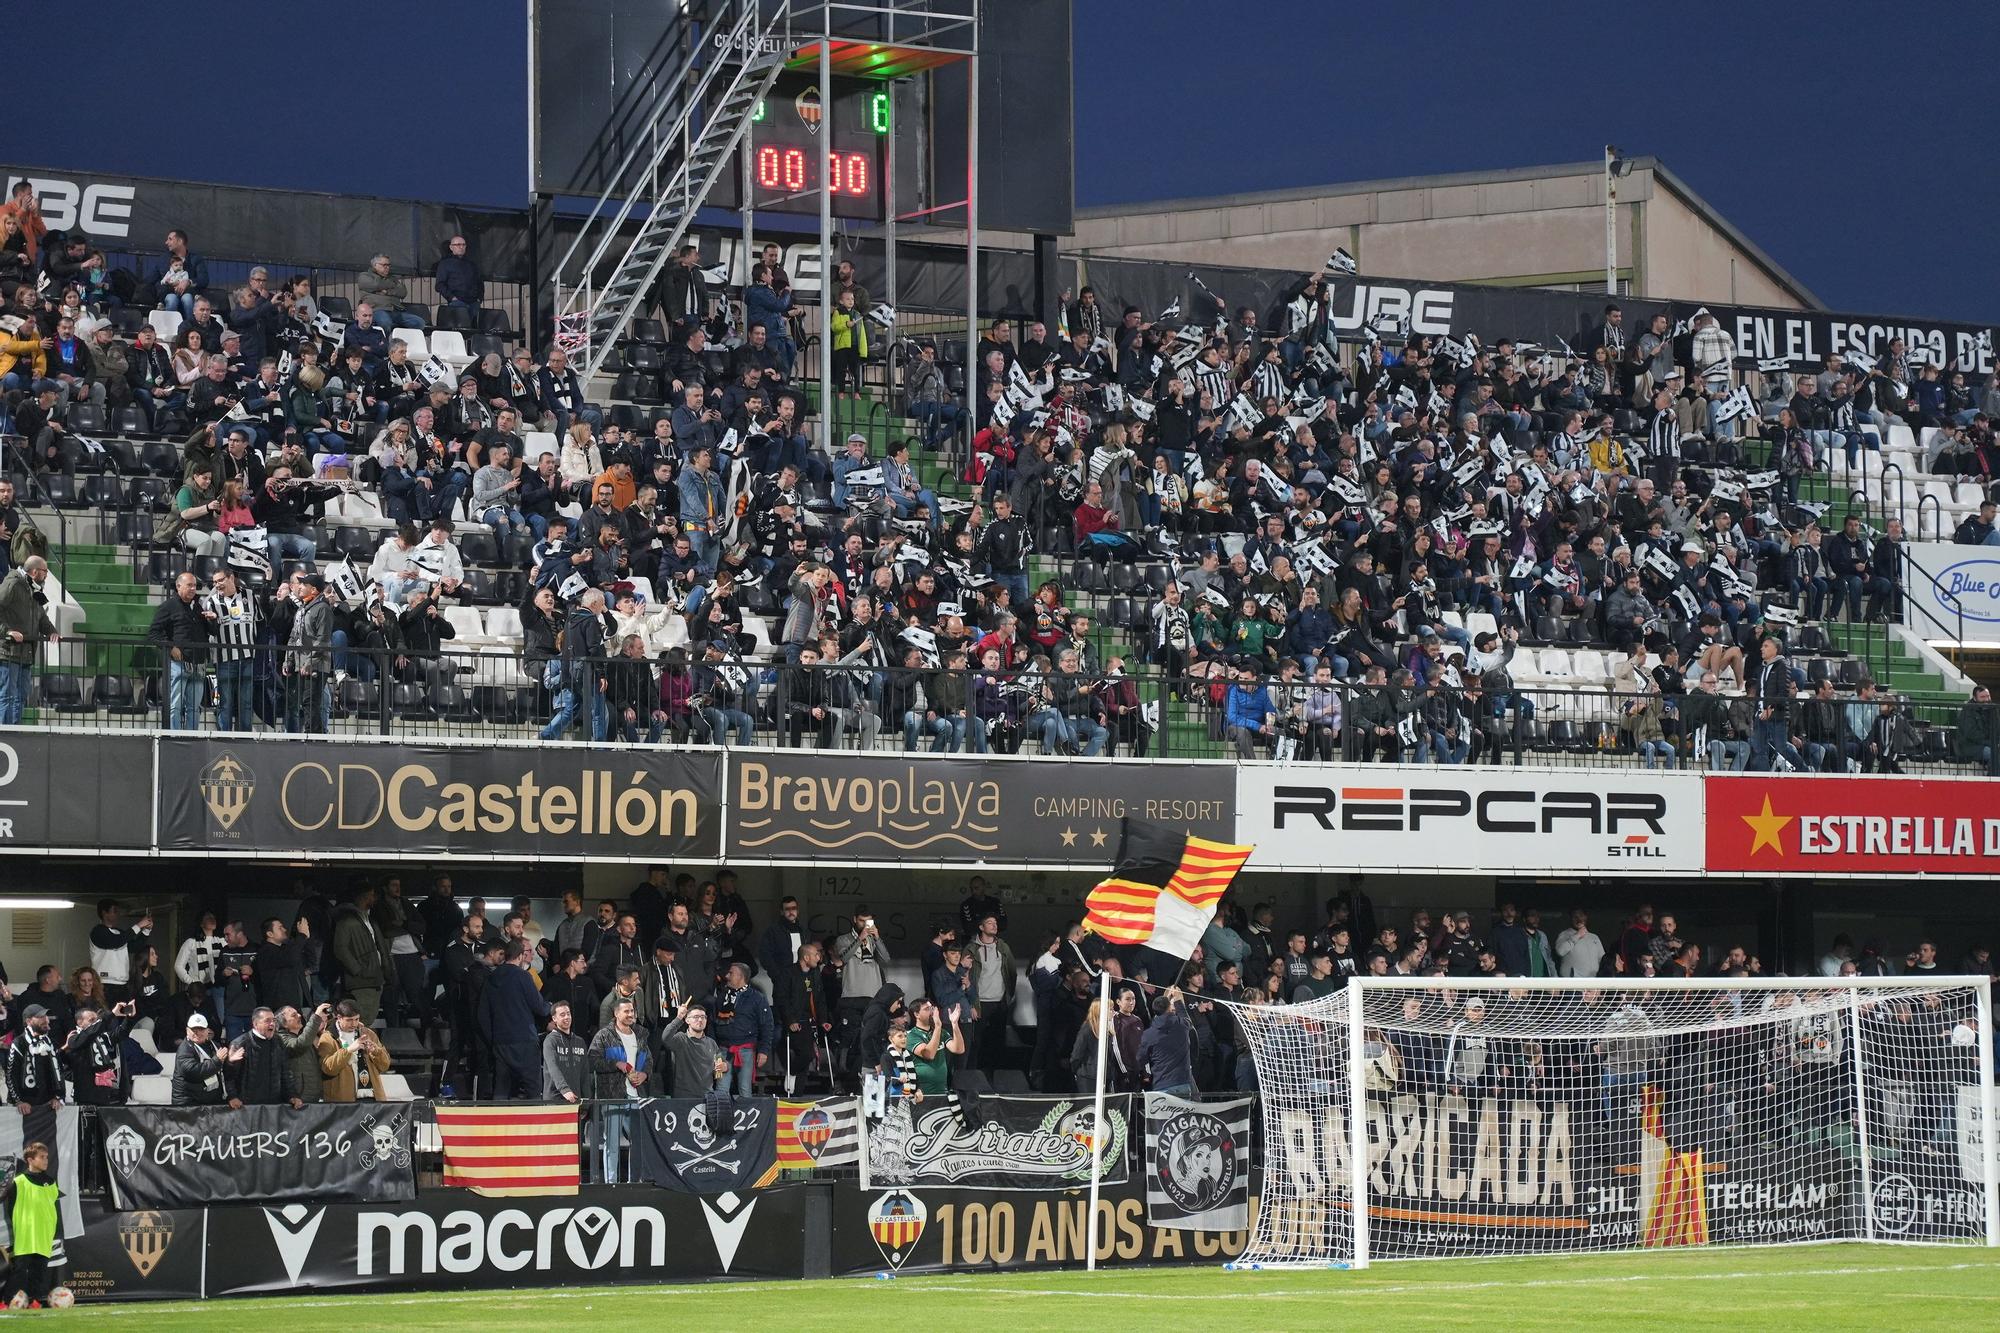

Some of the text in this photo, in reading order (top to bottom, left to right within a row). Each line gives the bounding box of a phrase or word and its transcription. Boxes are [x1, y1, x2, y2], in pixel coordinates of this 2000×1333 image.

[4, 176, 136, 237] BE
[1736, 315, 1775, 359] EN
[1786, 319, 1822, 362] EL
[1941, 572, 1985, 602] Blue
[281, 762, 697, 837] CDCastellón
[739, 762, 1000, 830] Bravoplaya
[1034, 797, 1125, 819] CAMPING
[1146, 799, 1225, 821] RESORT
[1274, 785, 1667, 835] REPCAR
[1608, 846, 1667, 857] STILL
[1799, 815, 1976, 856] ESTRELLA
[653, 1107, 761, 1134] 19 22
[905, 1105, 1083, 1163] Pirates
[1159, 1115, 1222, 1160] XIXIGANS
[153, 1130, 352, 1165] GRAUERS 136
[1167, 1181, 1186, 1203] 1922
[357, 1206, 667, 1275] macron
[936, 1202, 1014, 1265] 100
[1025, 1189, 1144, 1262] AÑOS
[72, 1286, 106, 1295] ASTELLÓN
[78, 1279, 115, 1287] DEPORTIVO
